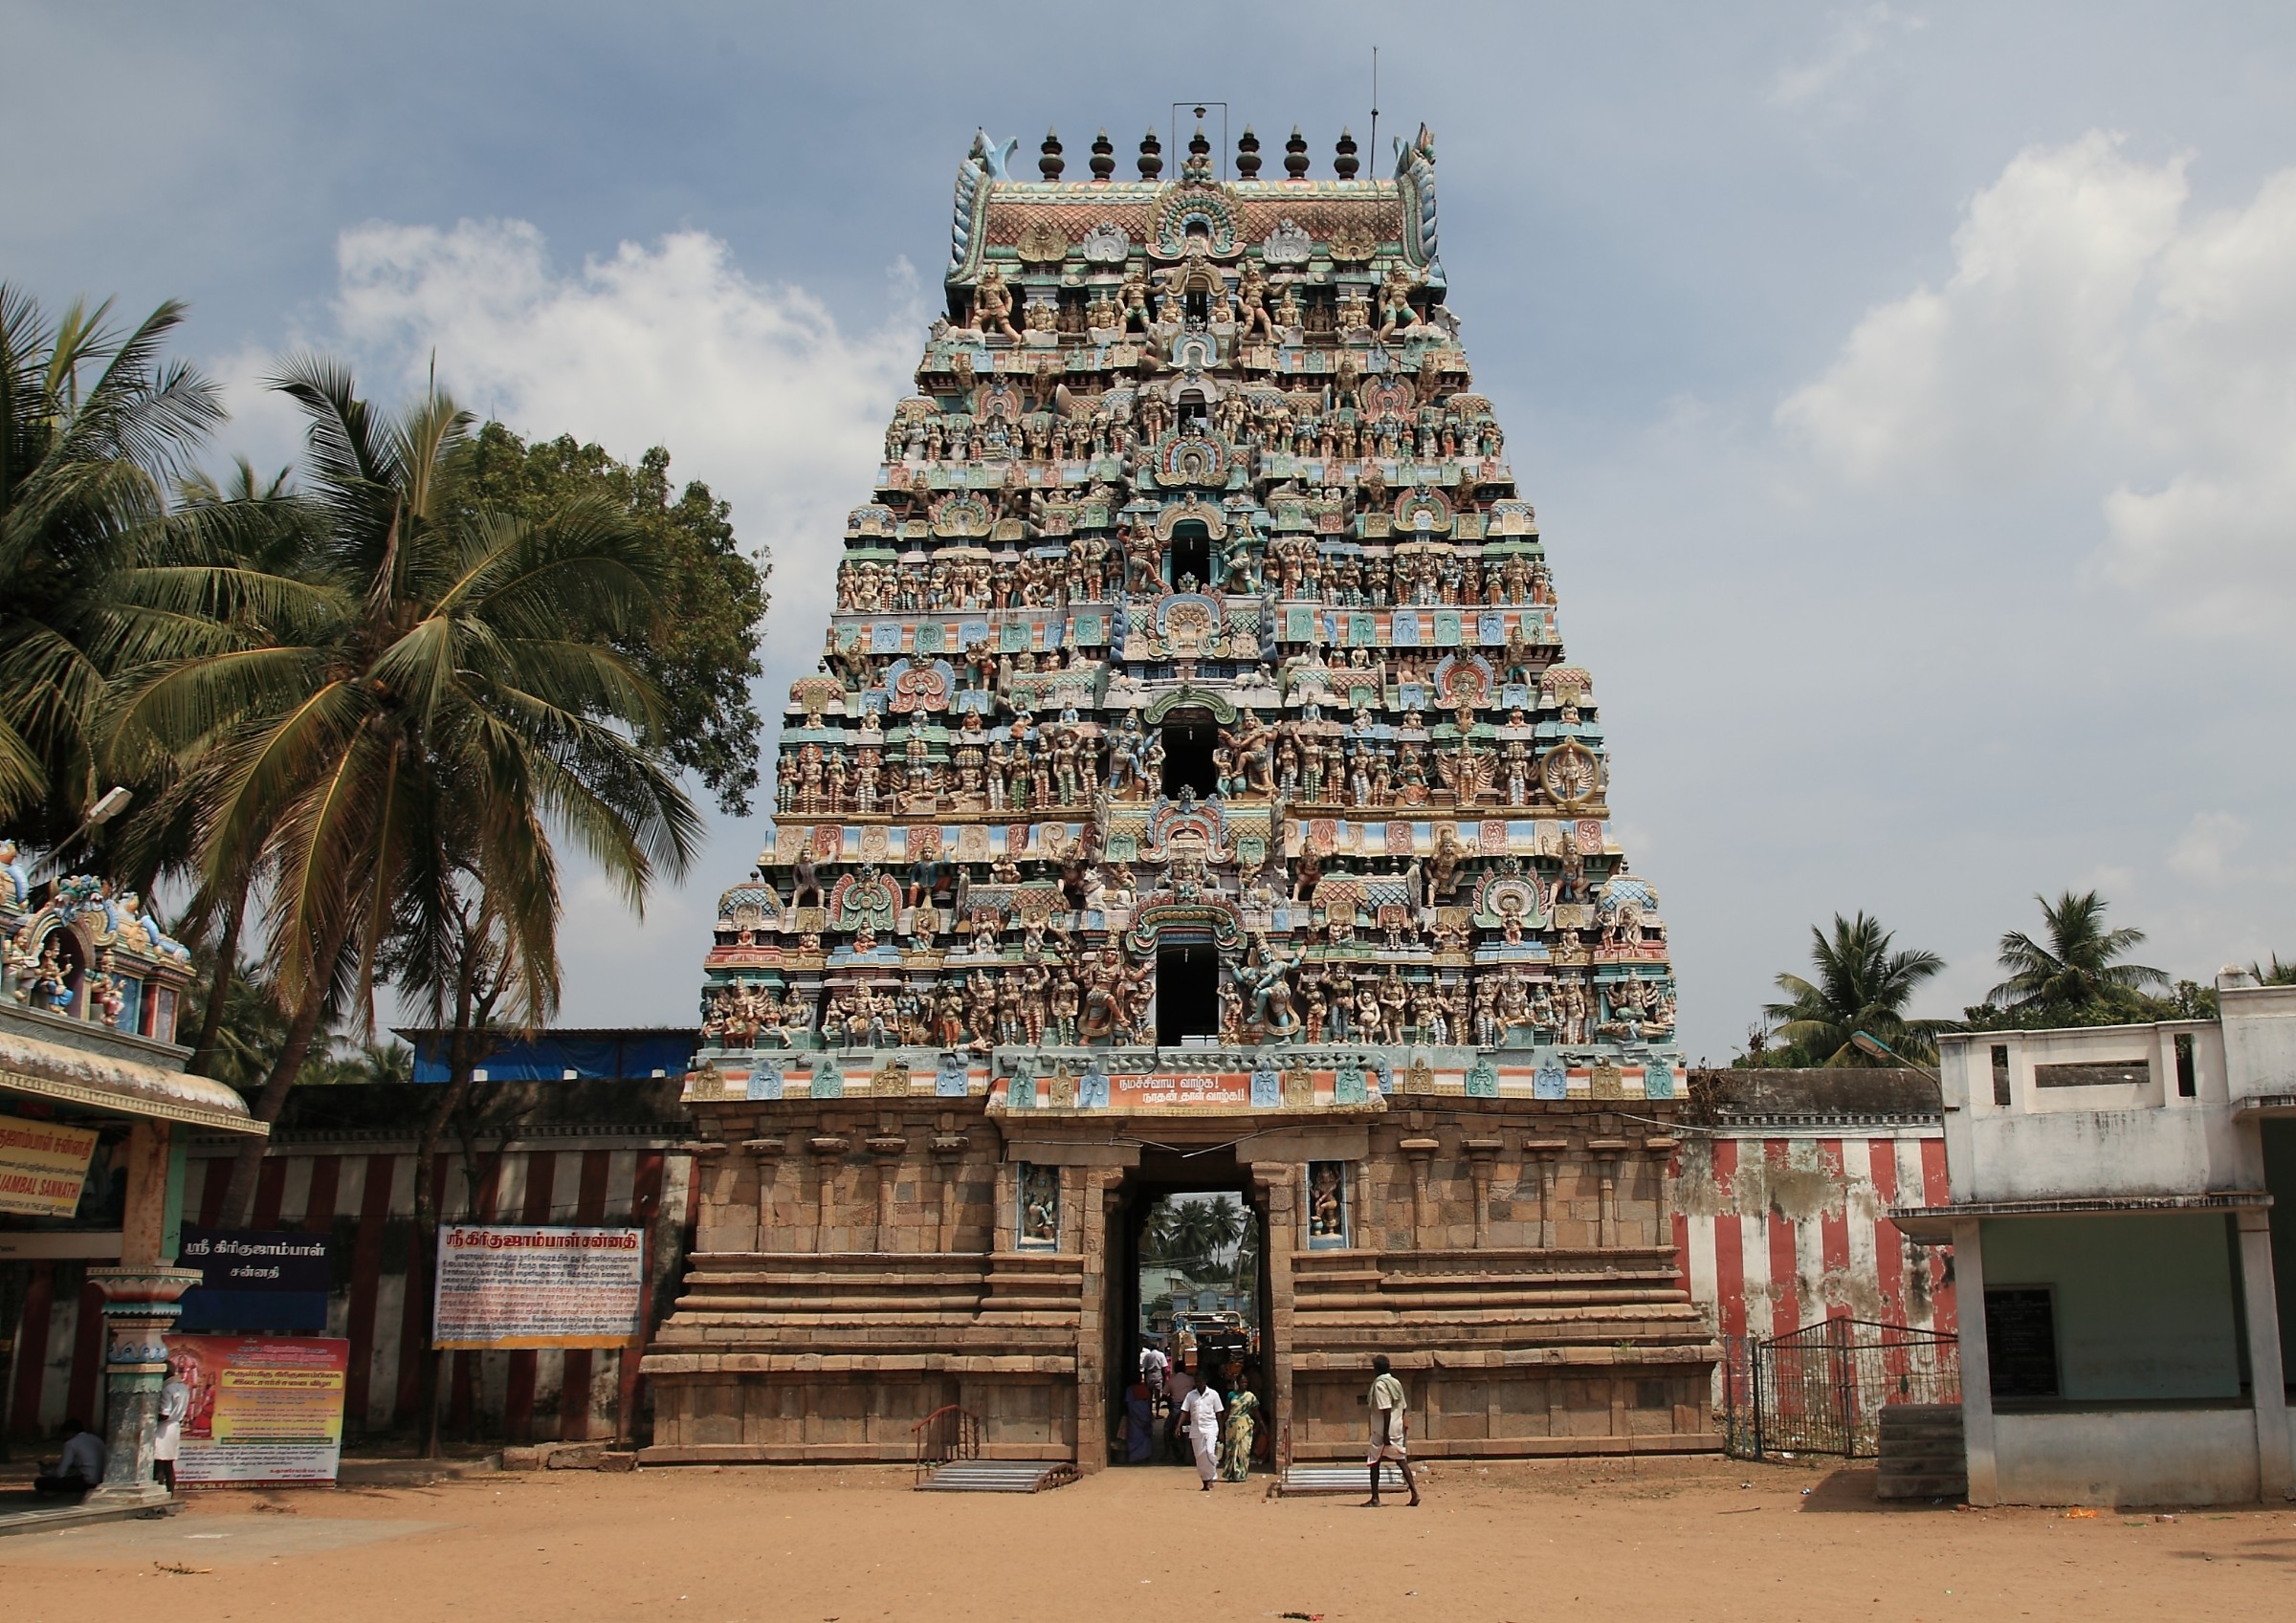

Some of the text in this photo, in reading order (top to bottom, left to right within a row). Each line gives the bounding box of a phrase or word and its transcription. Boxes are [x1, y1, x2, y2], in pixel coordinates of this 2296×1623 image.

[1119, 1076, 1176, 1090] நமச்சிவாய
[1142, 1089, 1178, 1103] நாதன்
[1179, 1088, 1205, 1103] தாள்
[466, 1231, 580, 1248] கிரிகுஜாம்பாள்
[213, 1239, 326, 1257] கிரிகுஜாம்பாள்
[230, 1265, 279, 1279] சன்னதி
